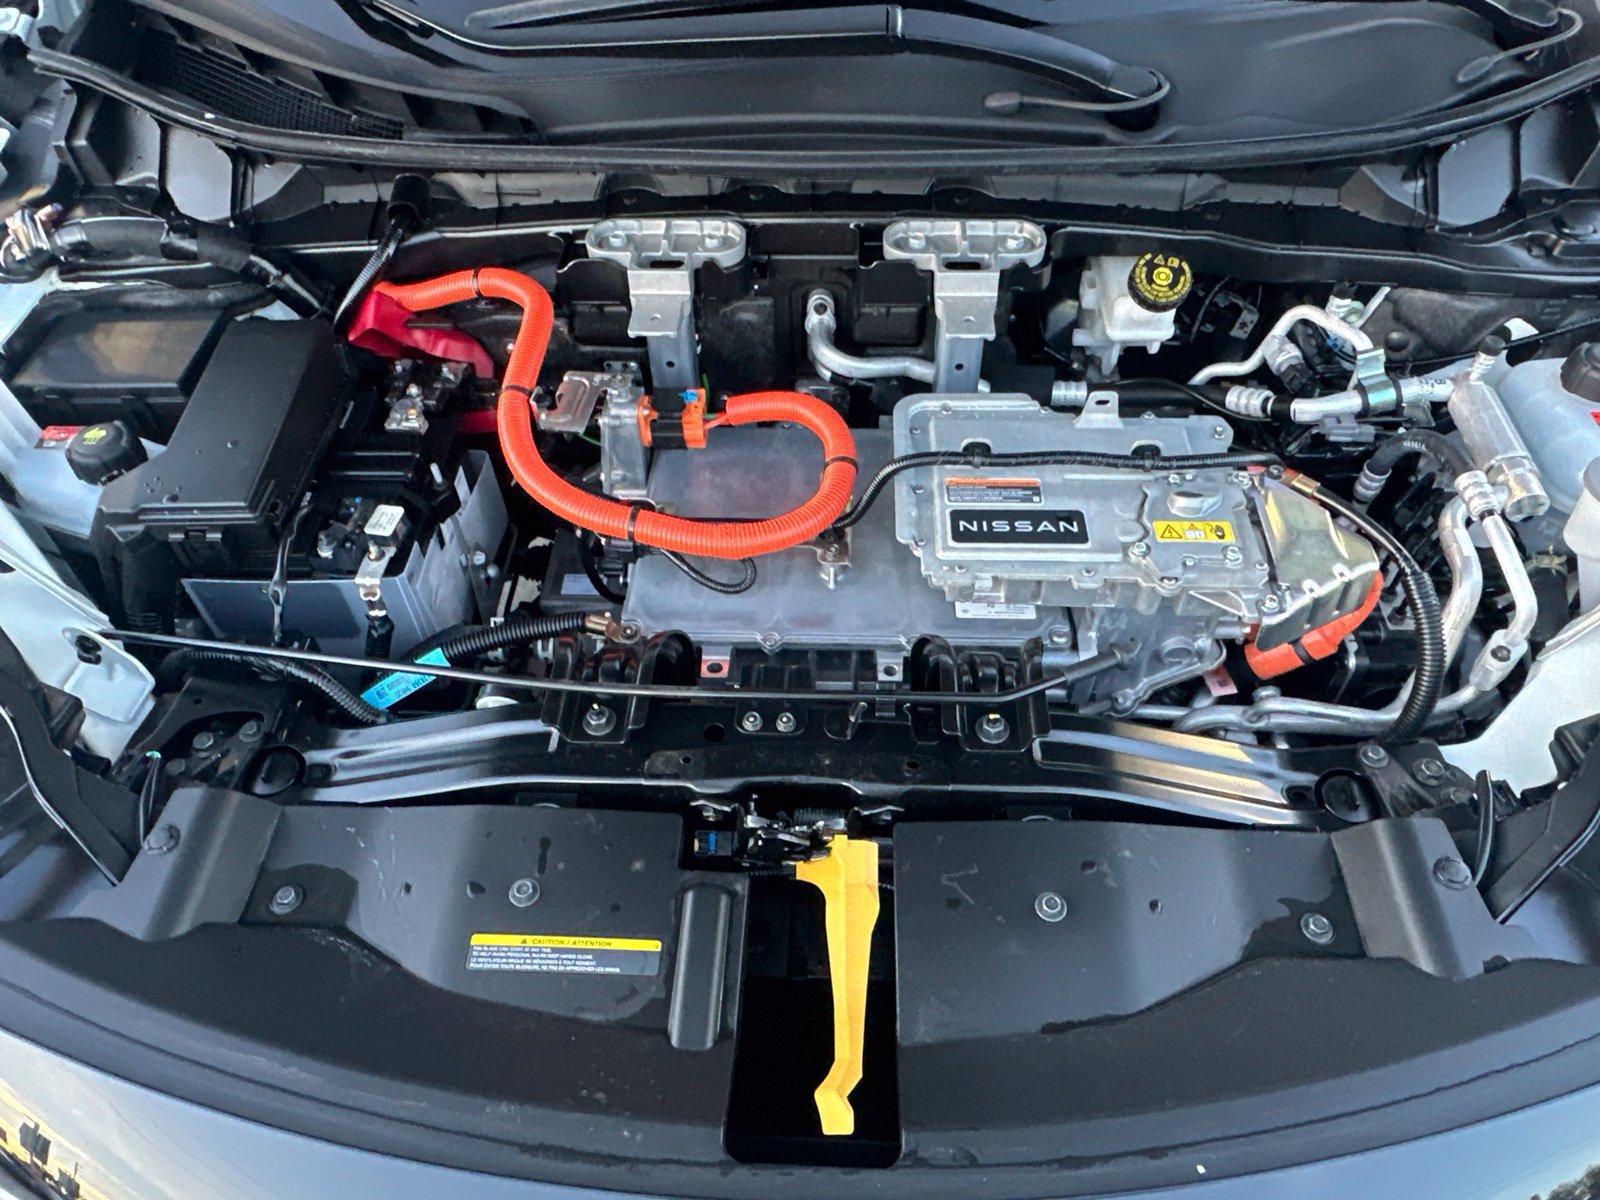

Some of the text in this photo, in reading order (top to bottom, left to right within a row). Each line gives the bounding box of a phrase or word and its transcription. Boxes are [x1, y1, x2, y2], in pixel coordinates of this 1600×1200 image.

[959, 520, 1079, 533] NISSAN
[532, 938, 565, 946] CAUTION
[572, 939, 612, 947] ATTENTION
